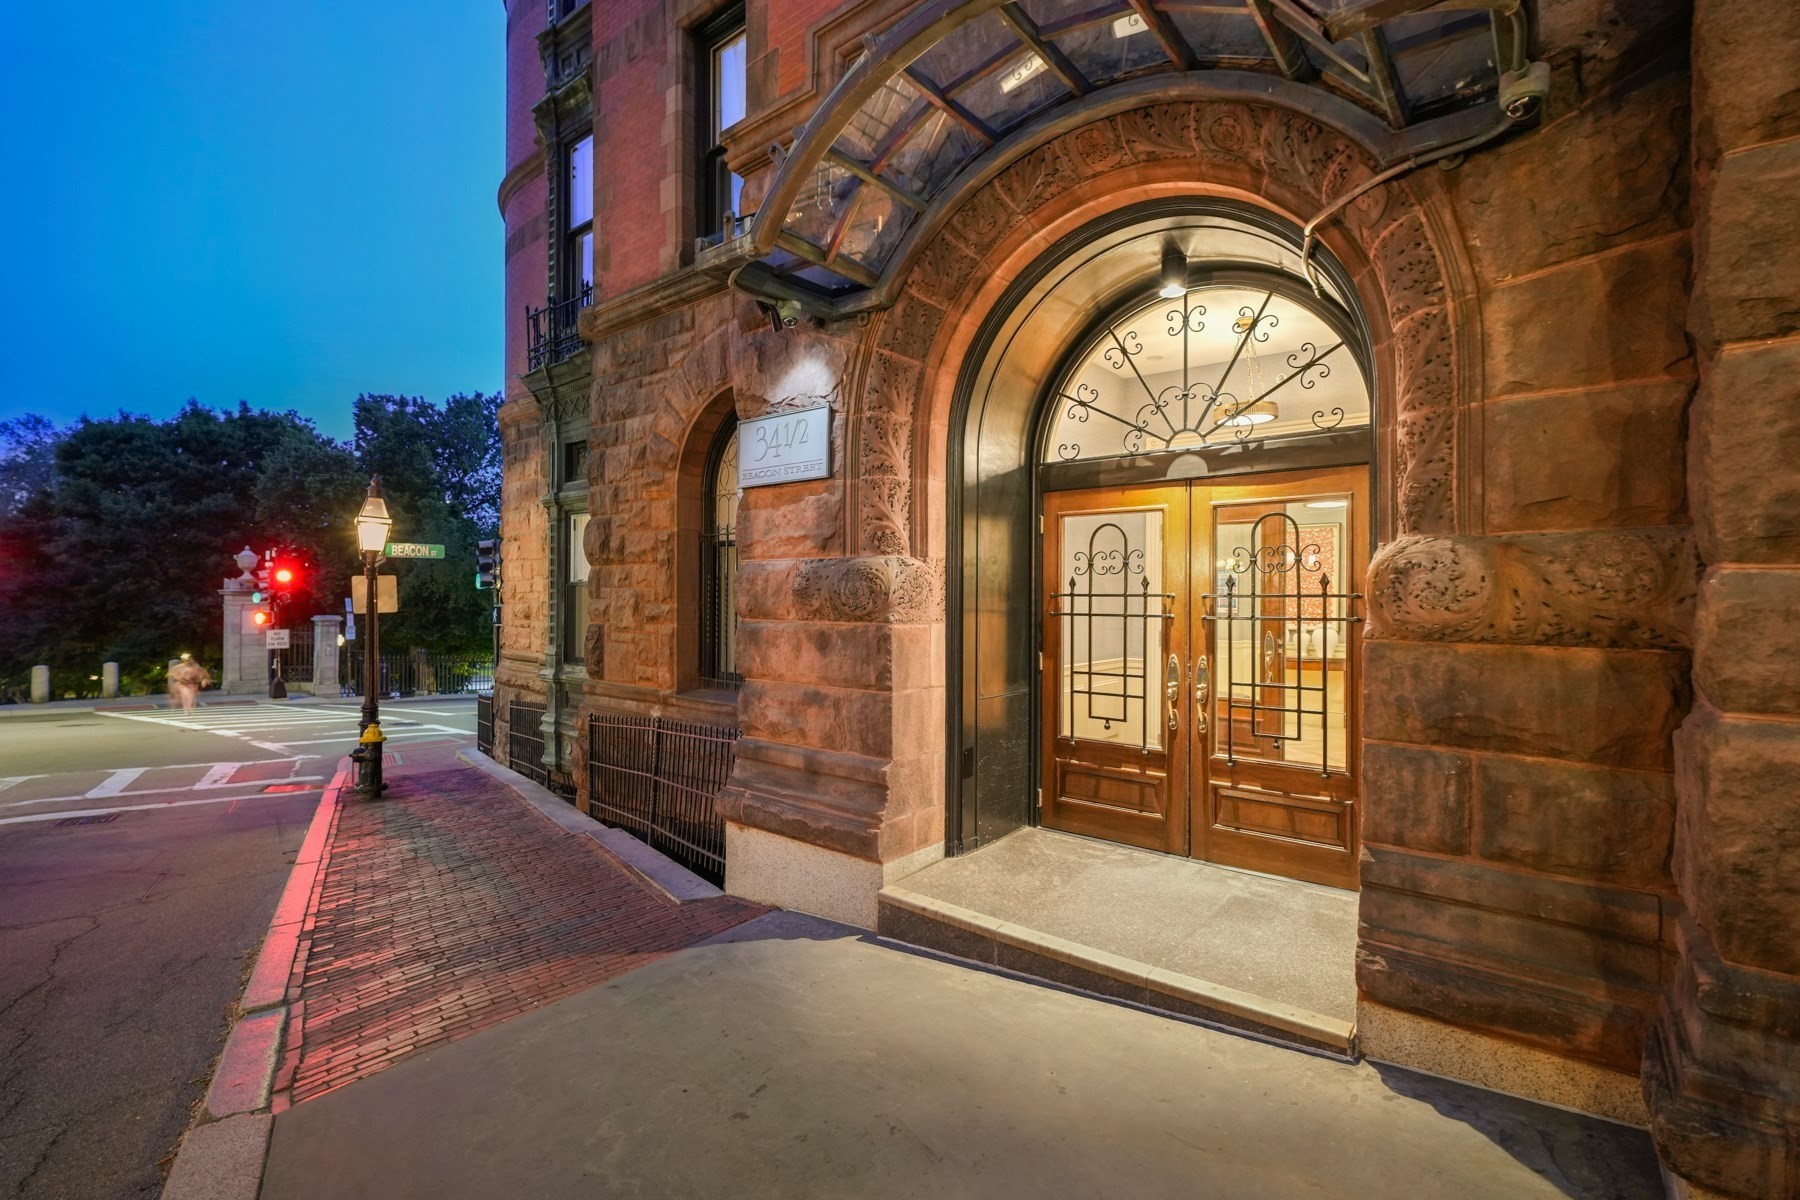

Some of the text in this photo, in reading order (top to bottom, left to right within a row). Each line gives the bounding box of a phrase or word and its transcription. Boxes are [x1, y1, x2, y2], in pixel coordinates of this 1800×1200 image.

[742, 462, 824, 480] BEACON STREET
[391, 545, 429, 556] BEACON
